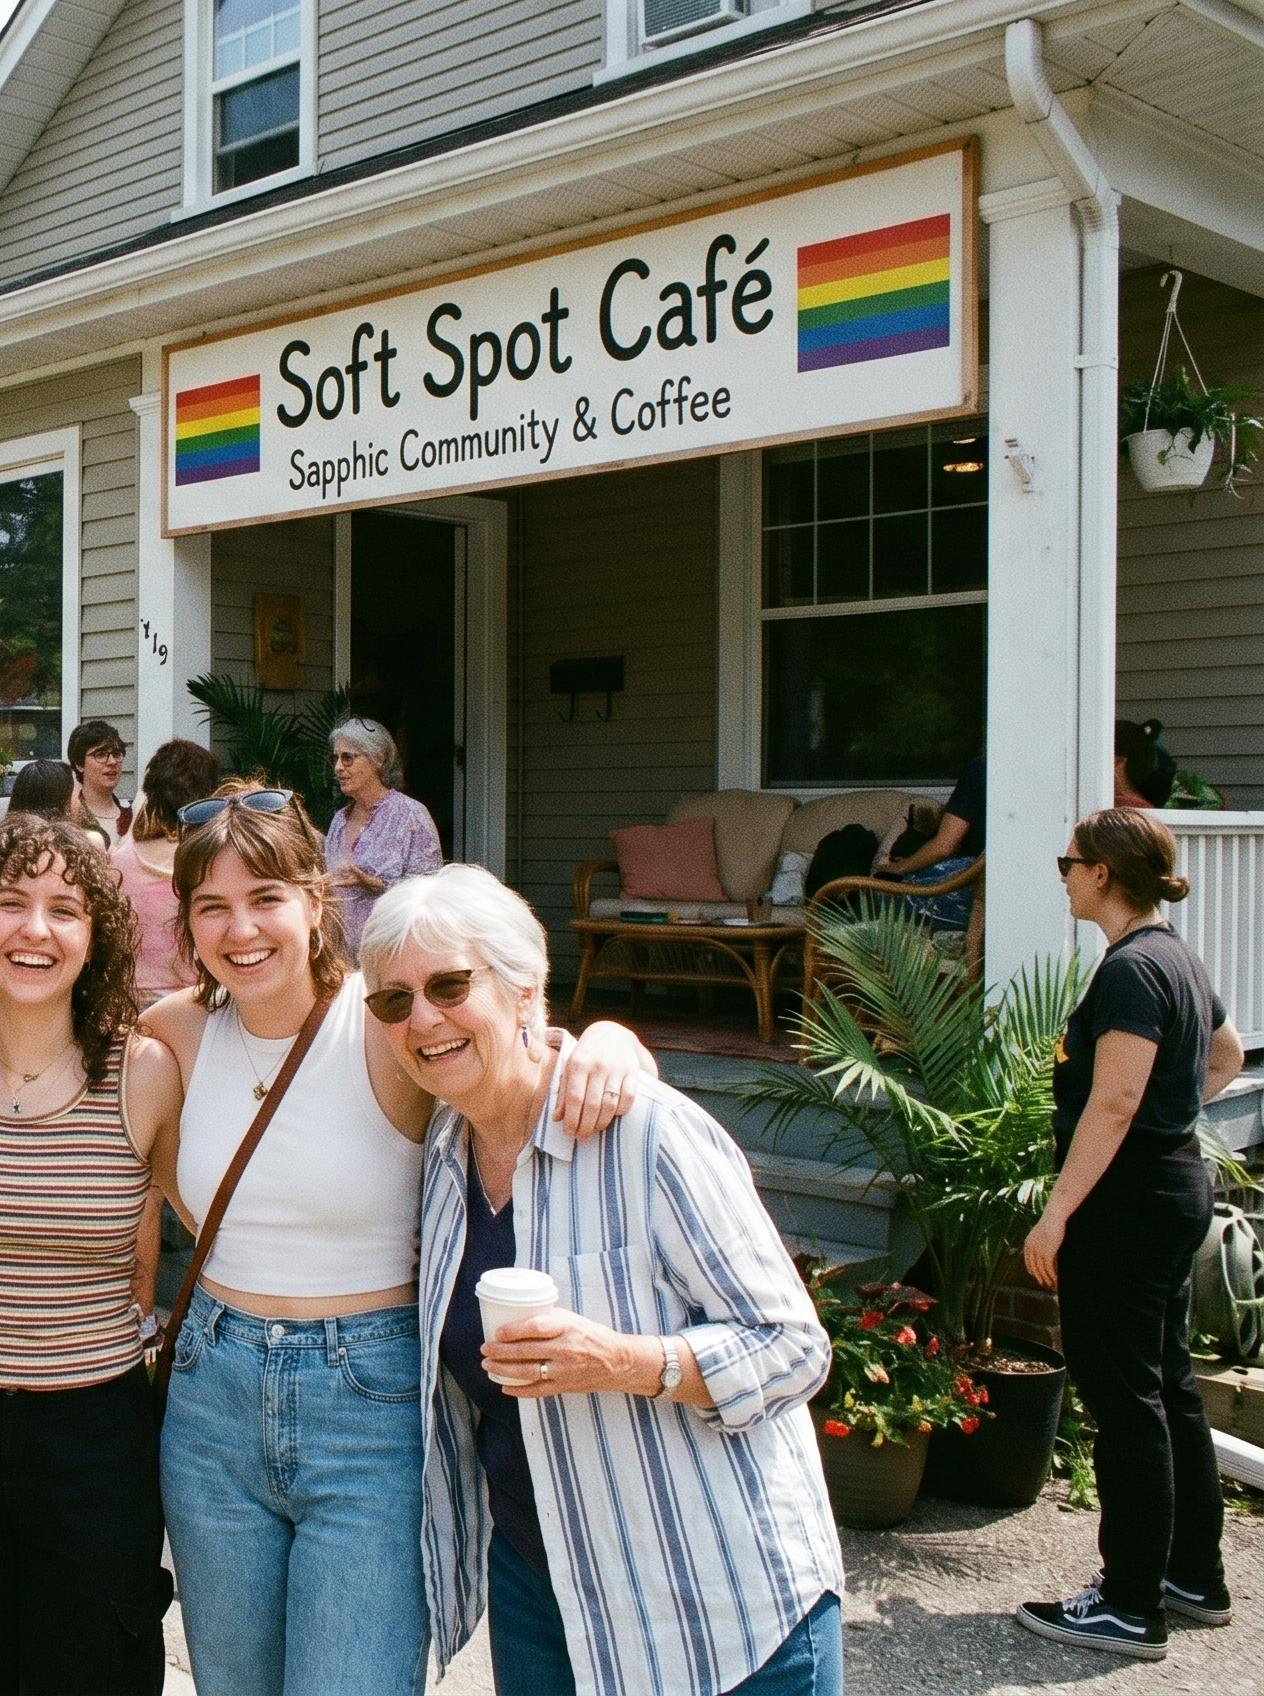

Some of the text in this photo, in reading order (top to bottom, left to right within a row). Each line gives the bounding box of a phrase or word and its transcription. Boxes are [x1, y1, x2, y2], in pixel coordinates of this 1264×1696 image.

[276, 233, 775, 429] Soft Spot Café
[288, 375, 732, 500] Sapphic Community & Coffee
